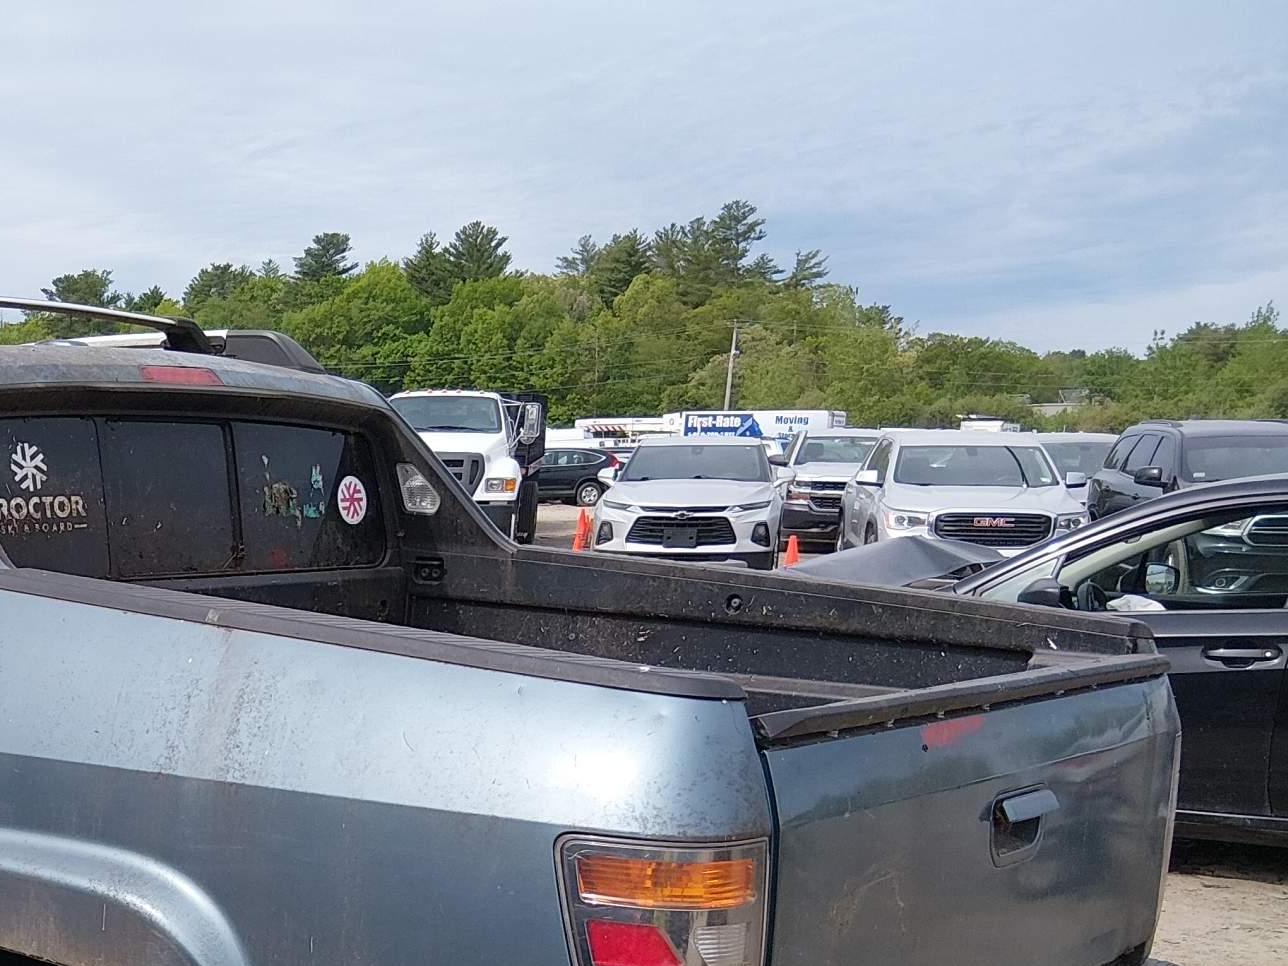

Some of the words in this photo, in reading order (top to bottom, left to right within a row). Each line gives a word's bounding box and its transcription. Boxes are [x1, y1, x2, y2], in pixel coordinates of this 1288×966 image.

[688, 415, 741, 428] First-Rate
[775, 415, 809, 426] Moving
[974, 517, 1015, 527] GMC
